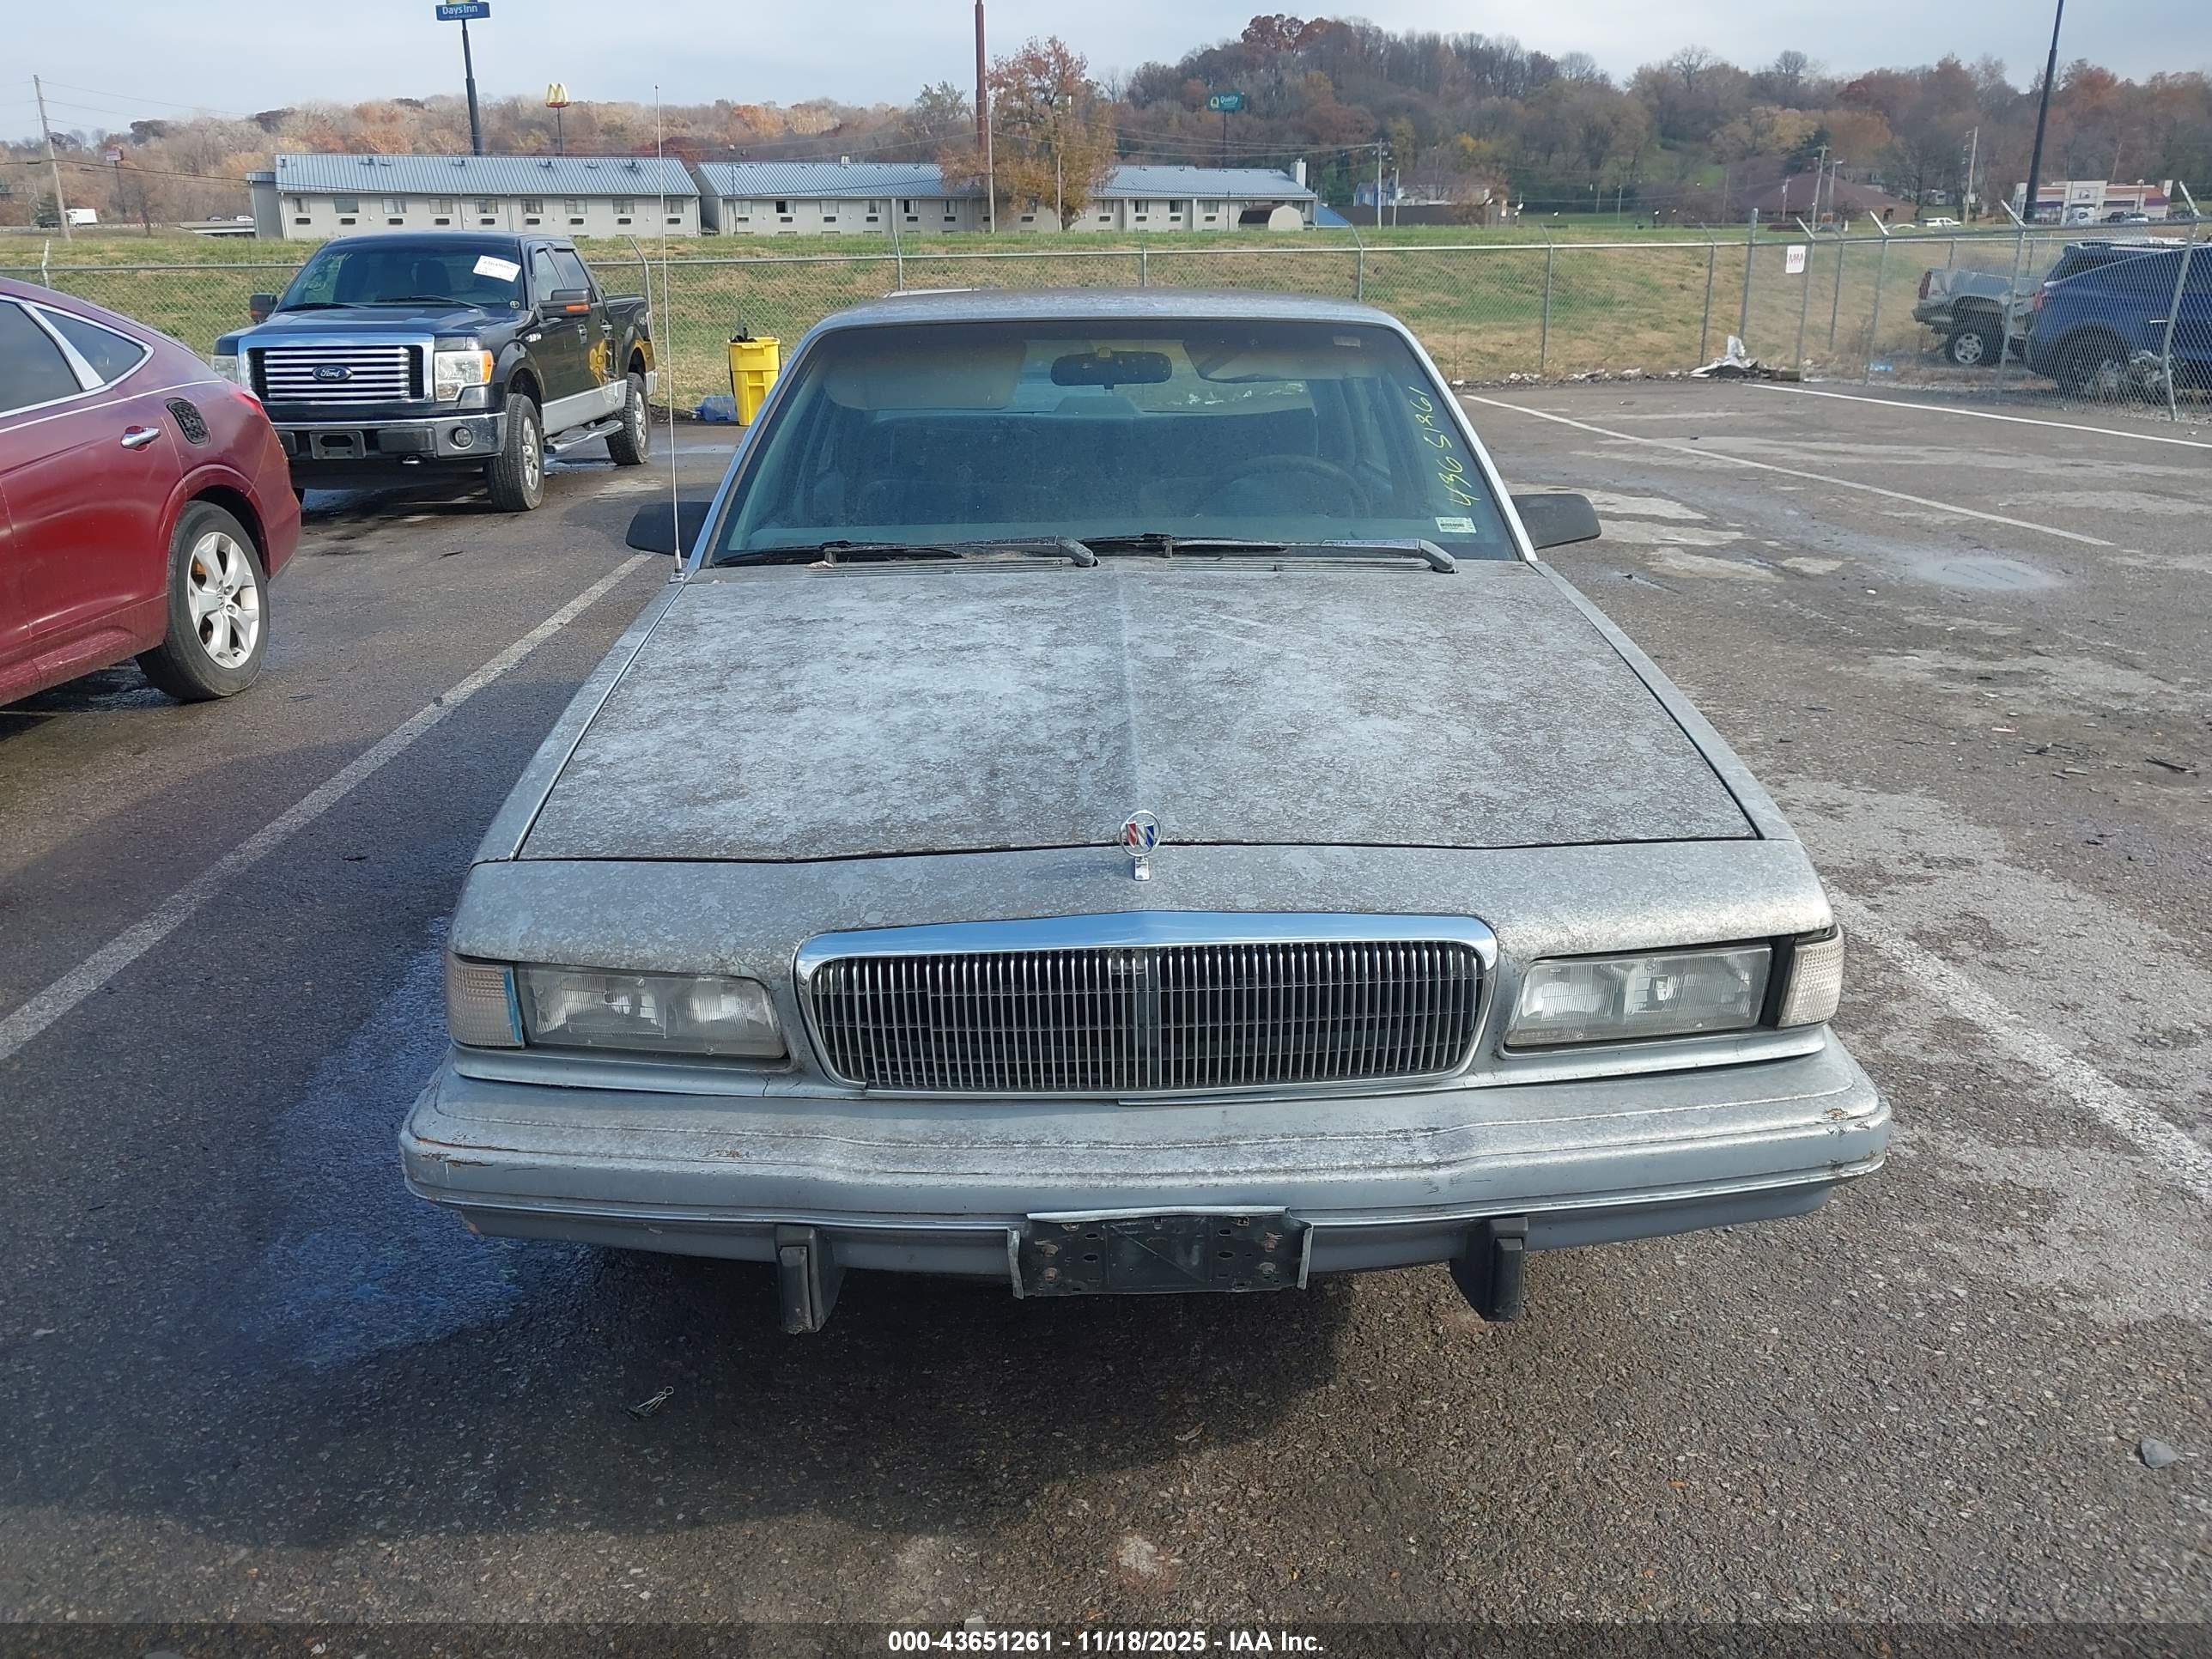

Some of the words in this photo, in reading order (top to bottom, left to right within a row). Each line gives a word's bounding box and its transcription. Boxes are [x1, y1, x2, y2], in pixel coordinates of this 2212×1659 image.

[442, 6, 462, 15] Days
[463, 4, 478, 13] Inn
[320, 368, 341, 378] Ford
[1437, 456, 1480, 507] 436
